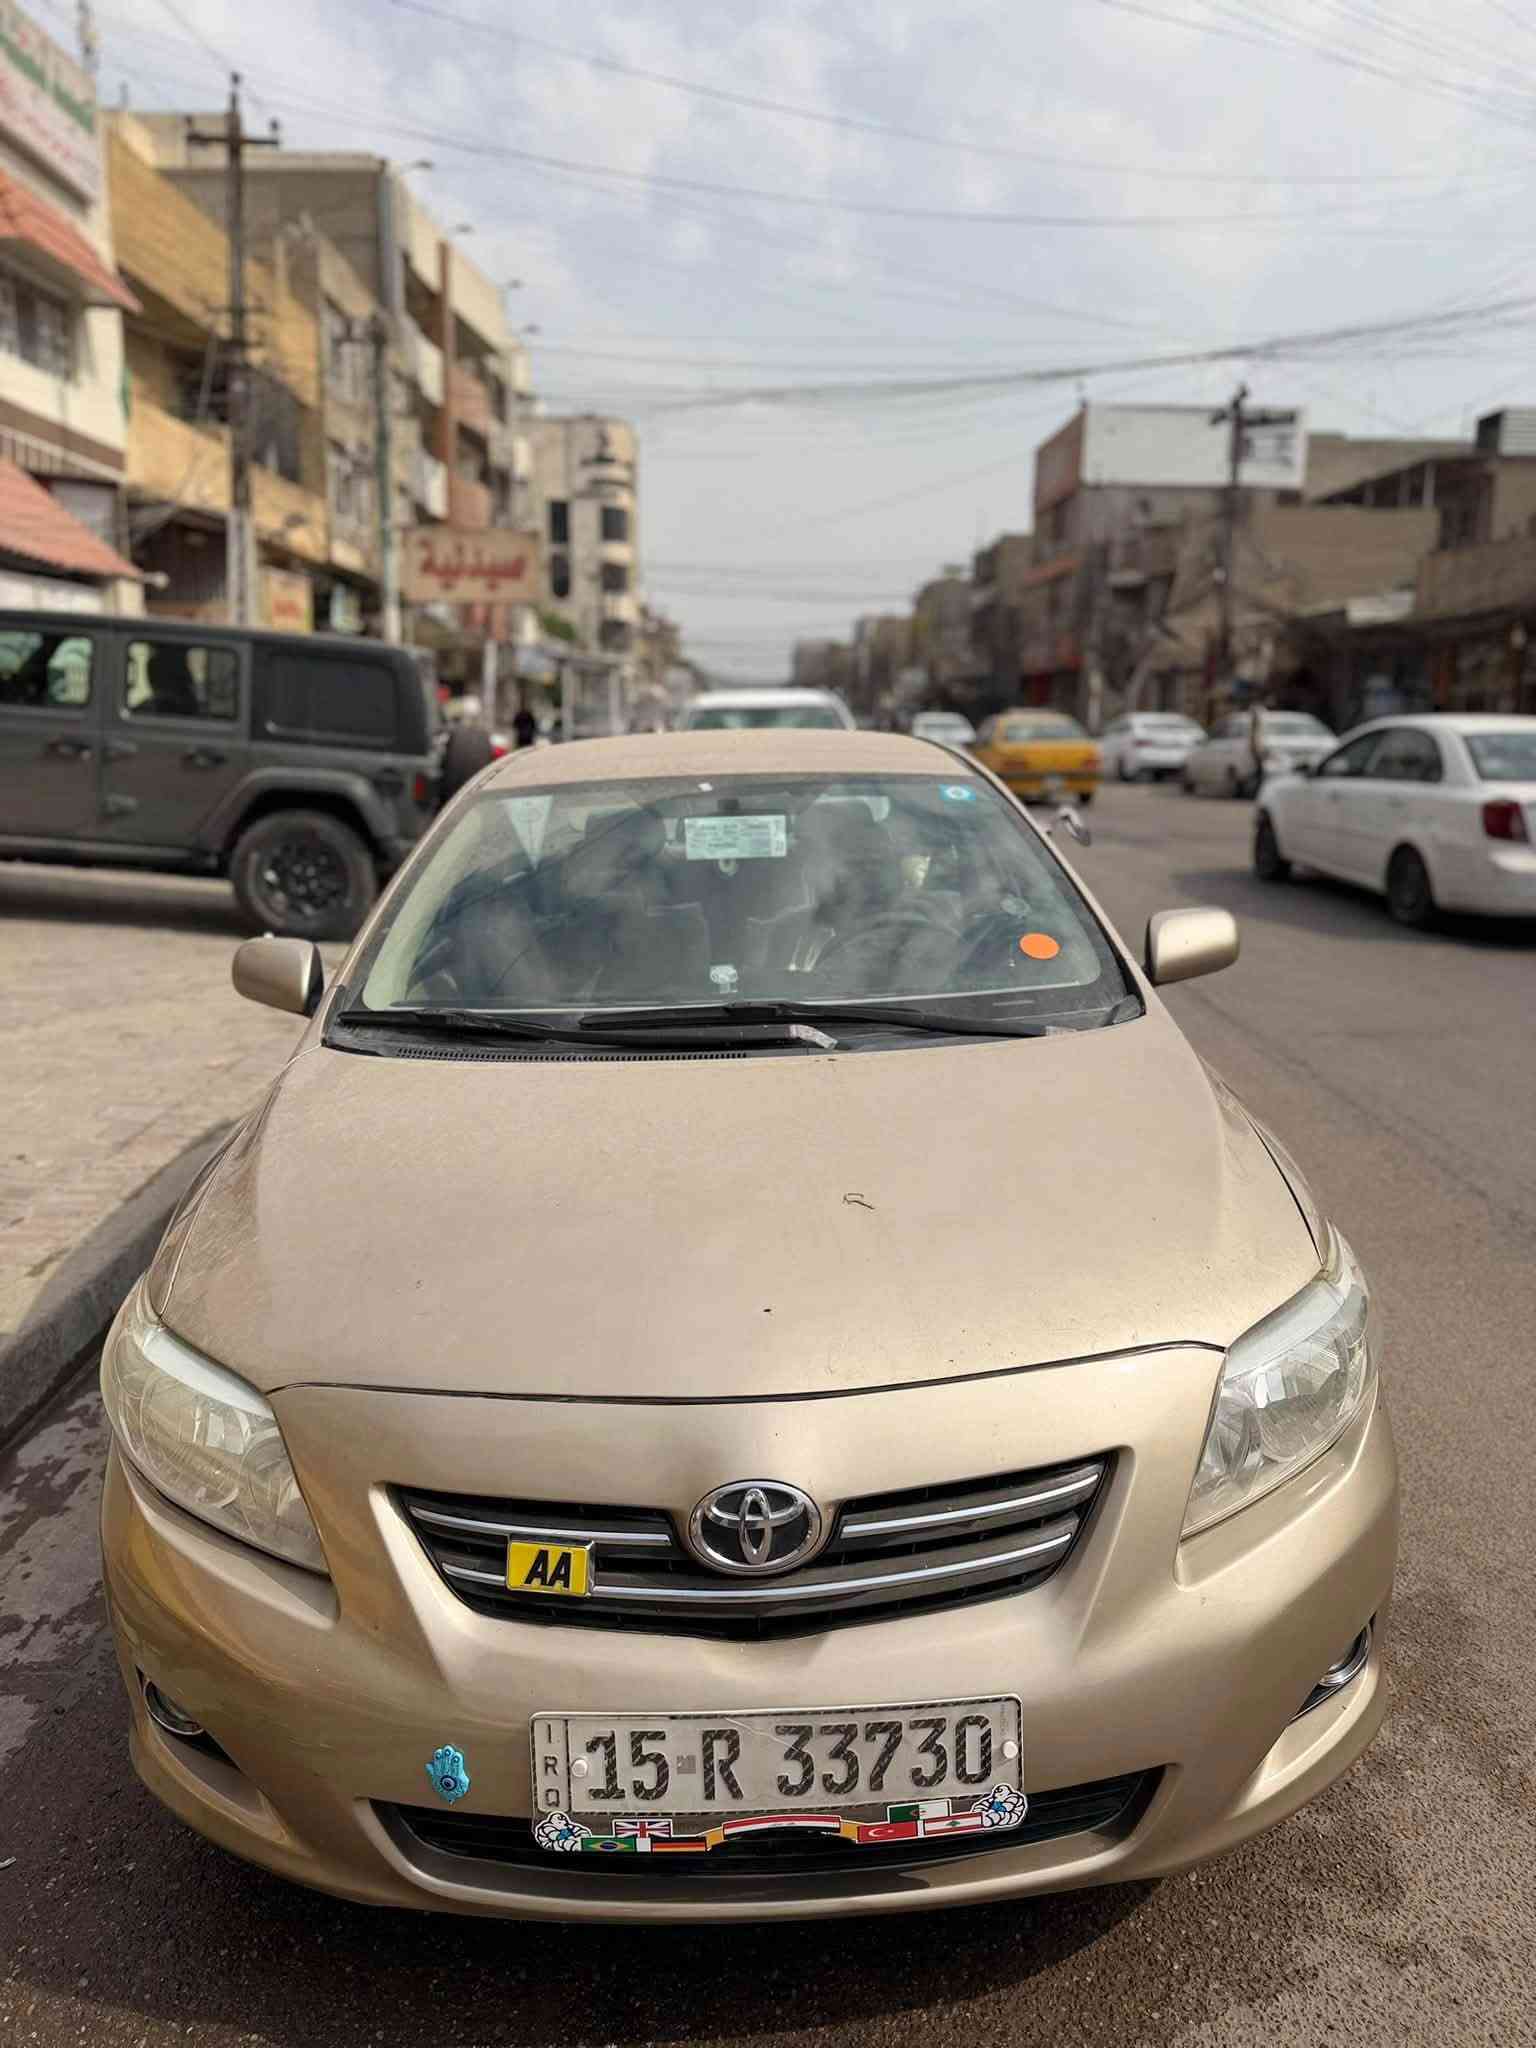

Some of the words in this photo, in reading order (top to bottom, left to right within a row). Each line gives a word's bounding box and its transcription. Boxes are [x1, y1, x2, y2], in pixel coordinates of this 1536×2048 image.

[523, 1549, 572, 1588] AA
[543, 1723, 561, 1808] IRQ
[585, 1730, 671, 1801] 15
[702, 1728, 744, 1801] R
[774, 1714, 993, 1797] 33730
